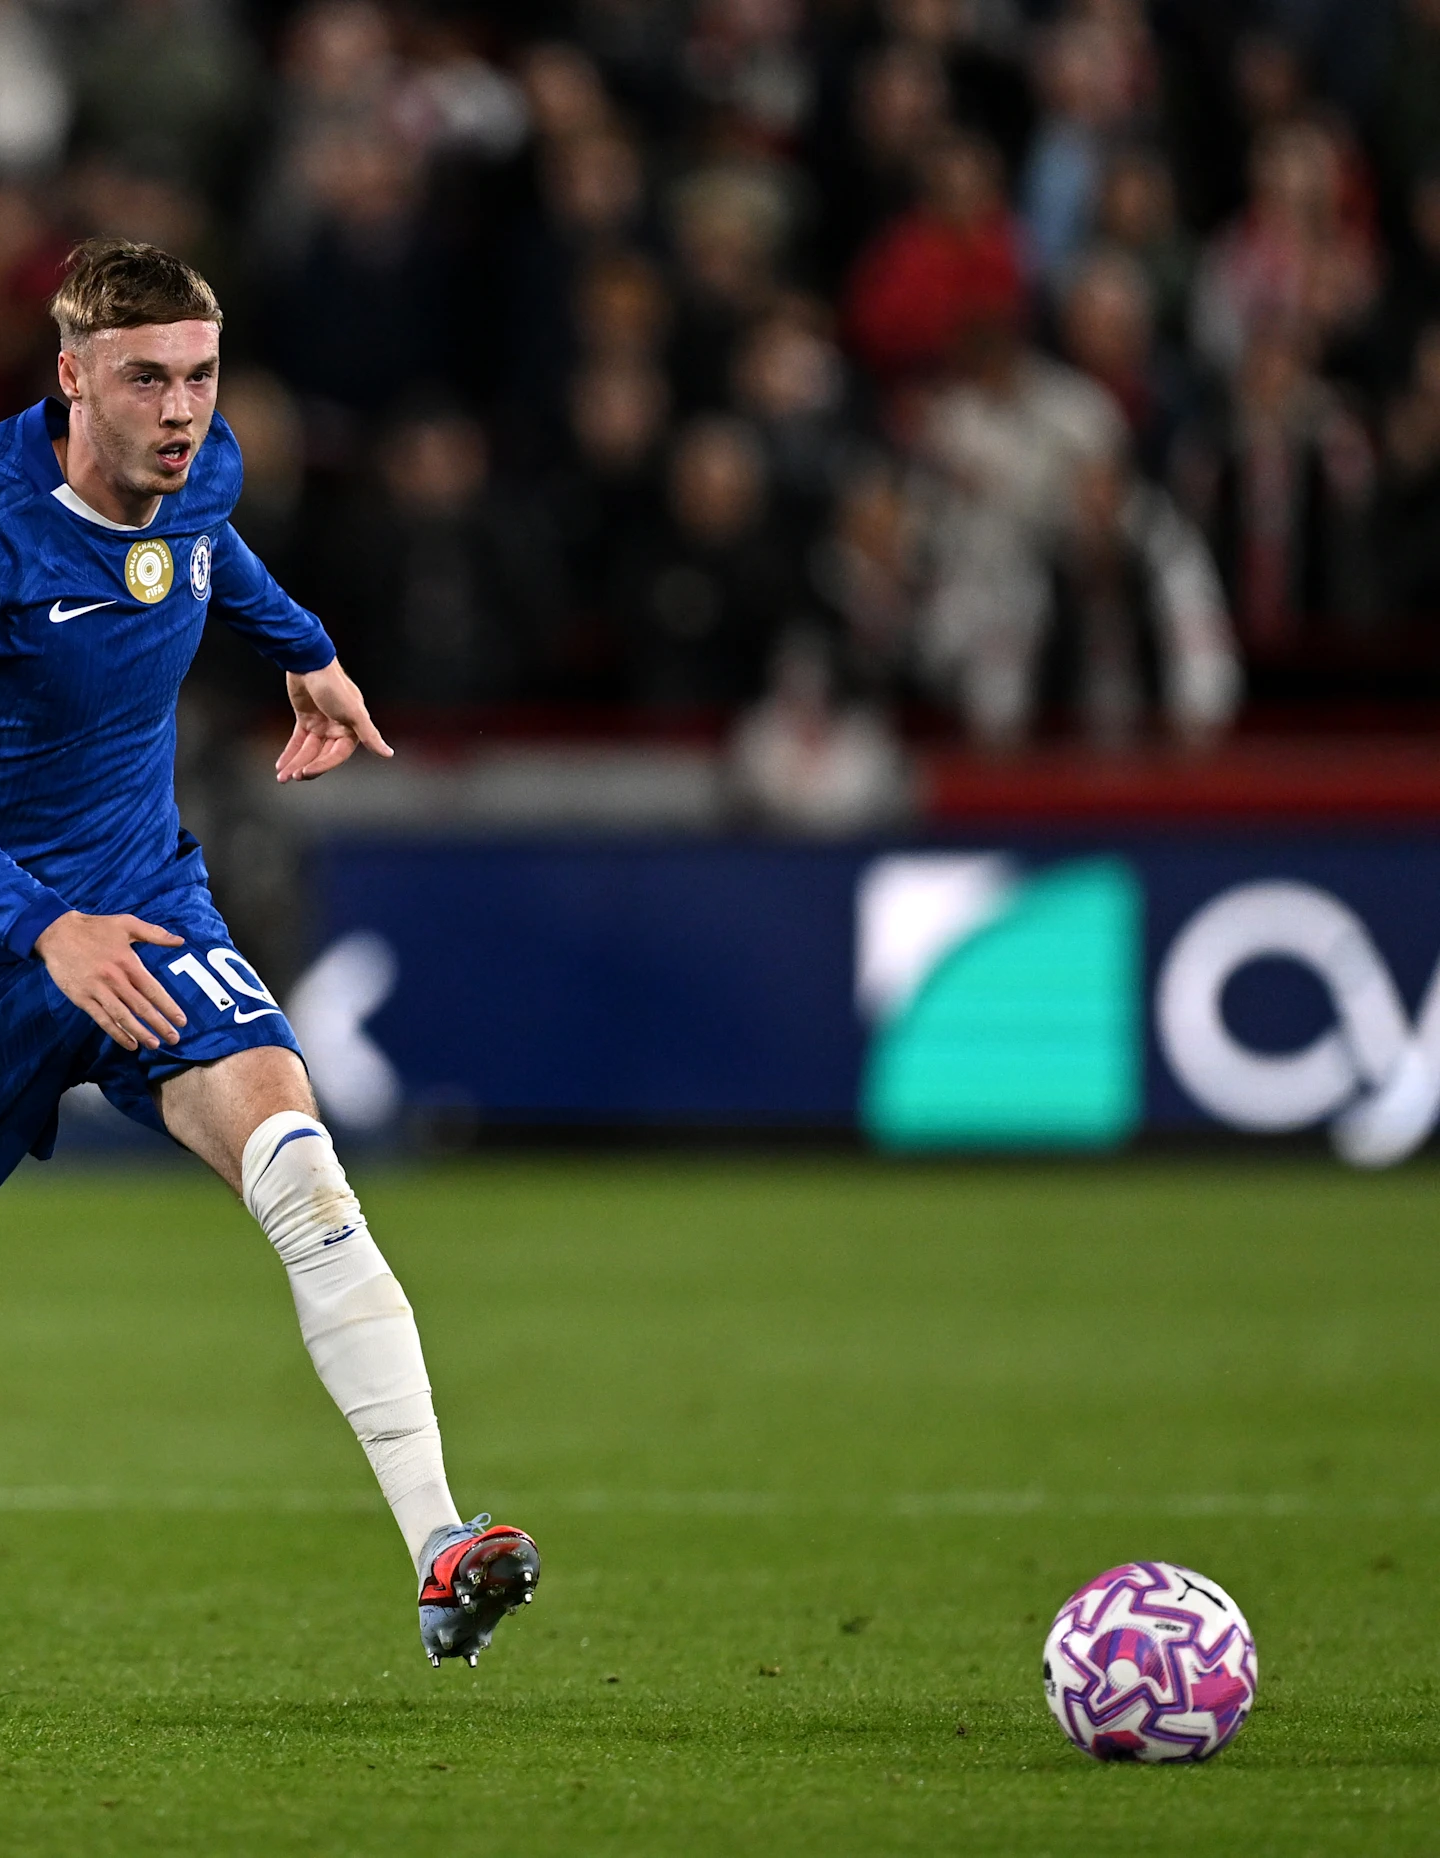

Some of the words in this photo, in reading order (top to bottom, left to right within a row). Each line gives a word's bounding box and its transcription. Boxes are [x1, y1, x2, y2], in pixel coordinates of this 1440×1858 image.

[129, 552, 138, 585] WORLD
[137, 542, 169, 569] CHAMPIONS
[145, 583, 165, 599] FIFA
[167, 947, 279, 1012] 10
